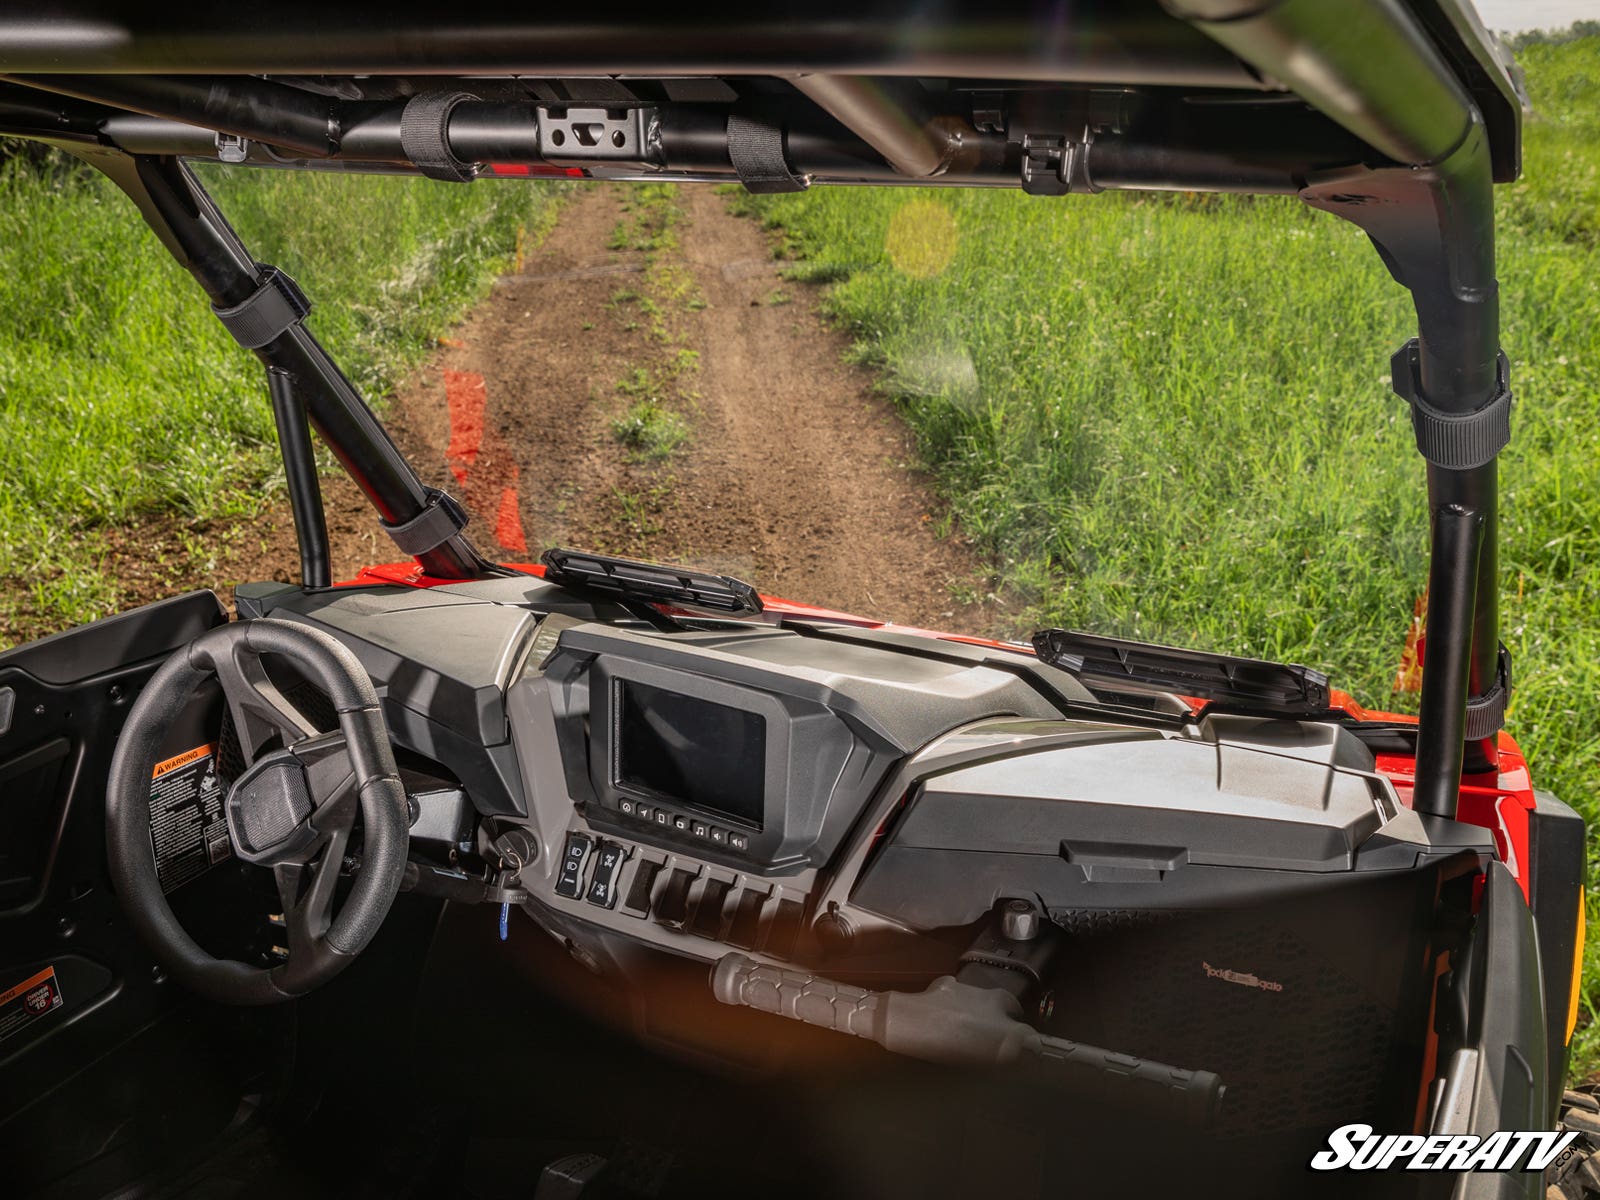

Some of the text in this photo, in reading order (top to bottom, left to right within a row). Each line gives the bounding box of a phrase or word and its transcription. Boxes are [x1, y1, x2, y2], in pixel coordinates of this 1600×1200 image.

[165, 751, 198, 770] WARNING
[27, 986, 49, 1001] DRIVER
[28, 992, 49, 1006] UNDER
[35, 1000, 46, 1010] 16
